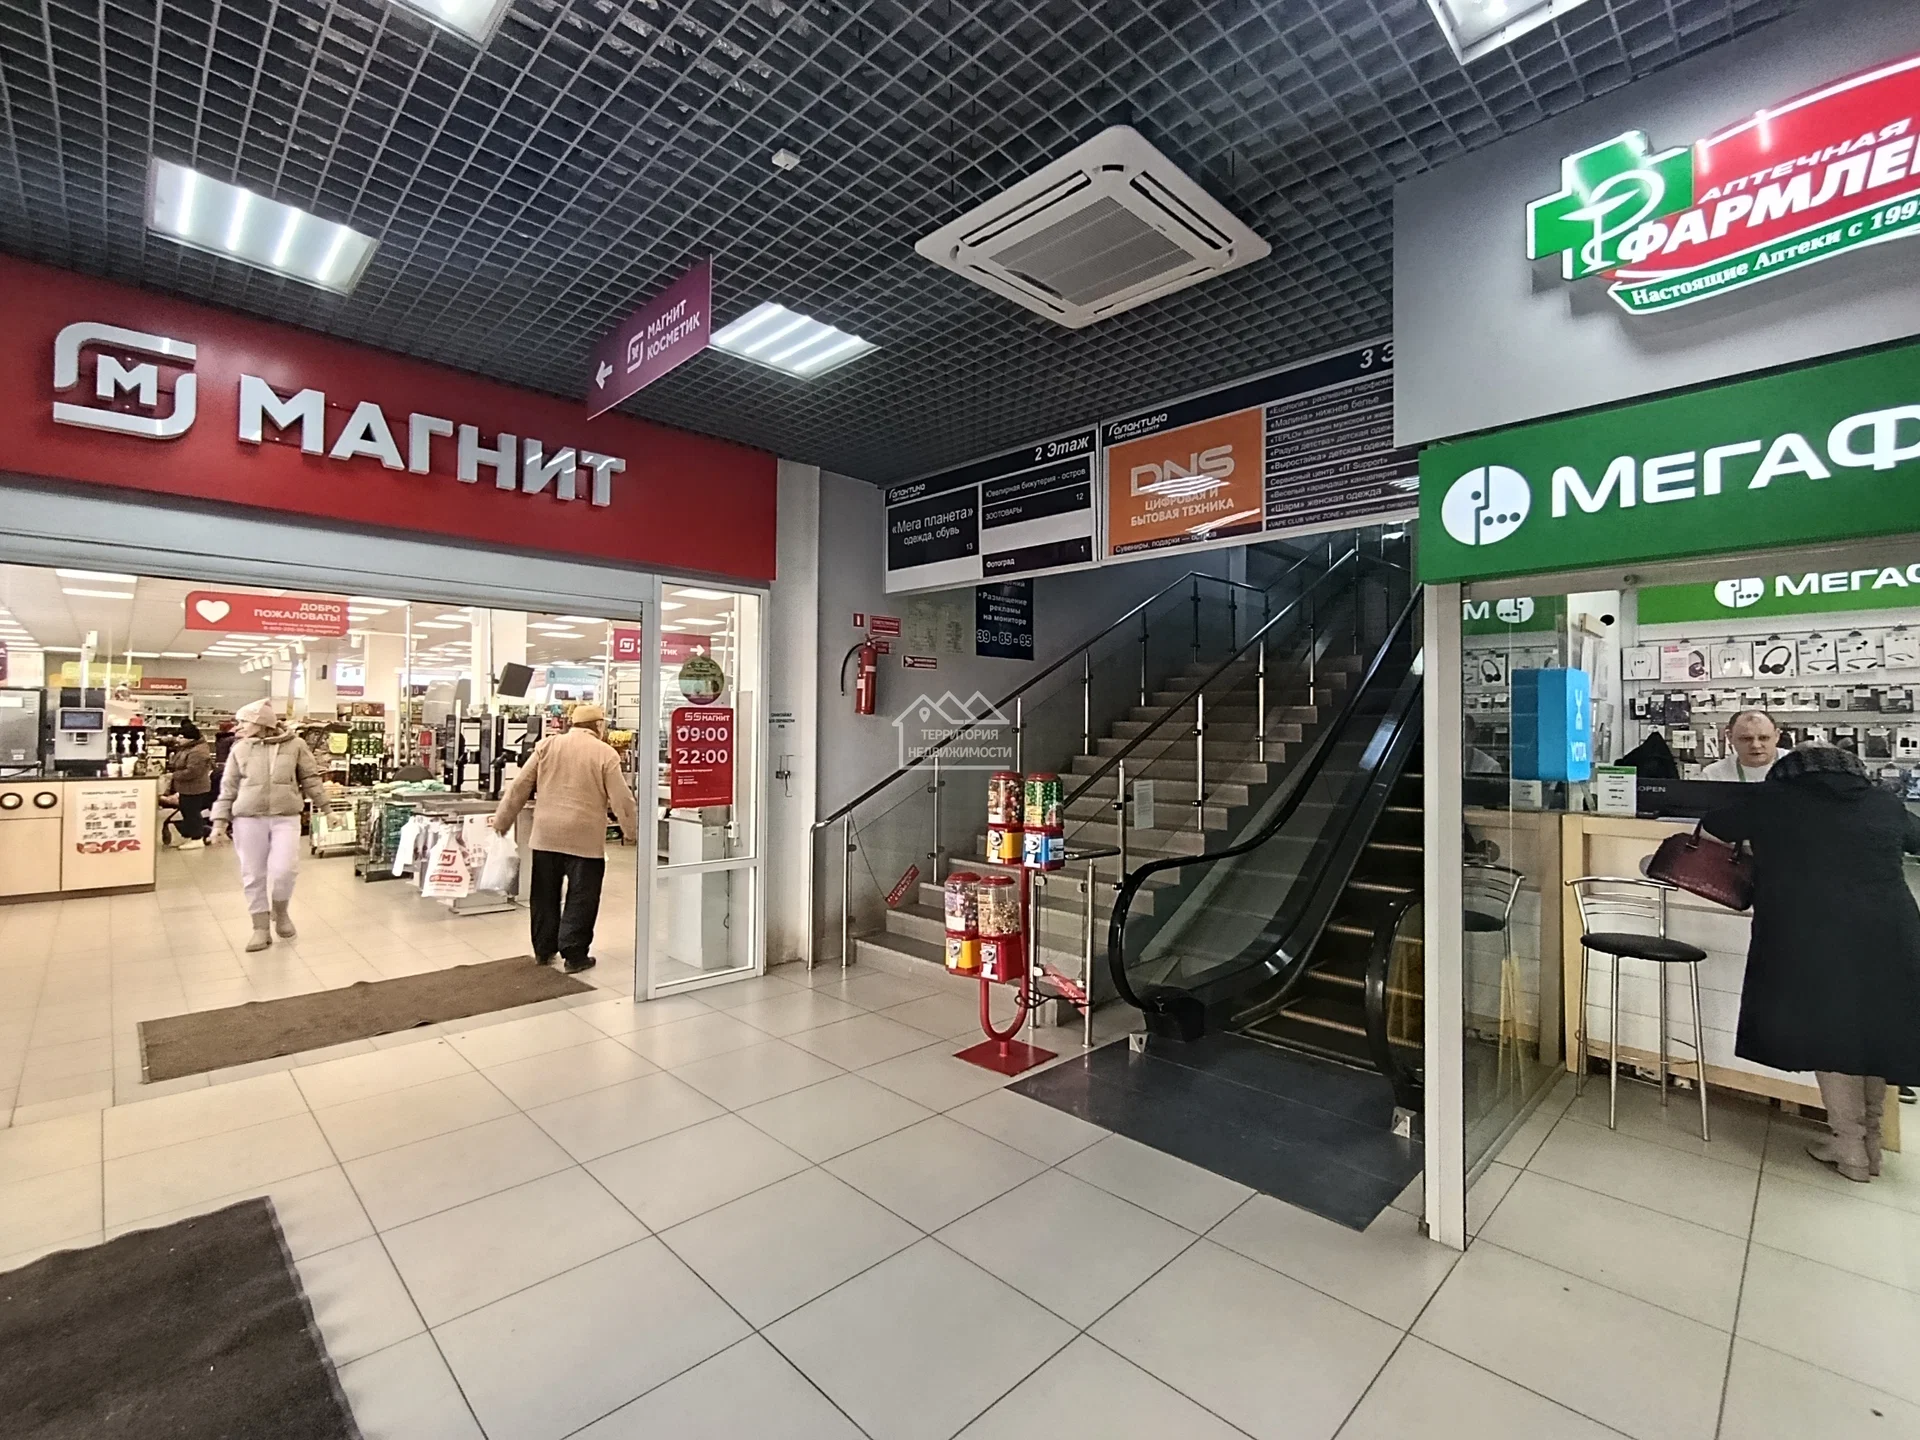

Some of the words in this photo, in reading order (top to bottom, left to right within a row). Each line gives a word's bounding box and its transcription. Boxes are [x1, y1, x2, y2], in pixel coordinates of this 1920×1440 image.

[1697, 117, 1912, 204] АПТЕЧНАЯ
[1617, 132, 1920, 262] ФАРМЛЕ
[1631, 262, 1748, 306] Настоящие
[1753, 229, 1842, 271] Аптеки
[1847, 221, 1864, 237] с
[1869, 199, 1920, 231] 199
[647, 299, 687, 340] МАГНИТ
[647, 311, 700, 361] КОСМЕТИК
[1360, 349, 1373, 369] 3
[1270, 413, 1313, 429] «Малина»
[1315, 404, 1349, 417] нижнее
[1351, 396, 1379, 409] белье
[1333, 415, 1365, 429] мужской
[239, 373, 626, 508] МАГНИТ
[1336, 430, 1369, 443] детская
[1370, 424, 1394, 435] одеж
[1034, 447, 1043, 461] 2
[1047, 436, 1090, 458] Этаж
[1328, 445, 1359, 459] детская
[1061, 468, 1086, 480] остров
[1130, 444, 1235, 498] DNS
[1270, 472, 1311, 486] Сервисный
[1312, 467, 1334, 479] центр
[1270, 486, 1306, 498] «Веселый
[1350, 469, 1397, 484] канцелярия
[1076, 492, 1084, 501] 12
[1270, 501, 1304, 513] «Шарм»
[1307, 494, 1344, 507] женская
[1346, 487, 1382, 500] одежда
[892, 520, 922, 534] «Мега
[924, 507, 974, 528] планета»
[985, 506, 1023, 520] ЗООТОВАРЫ
[1130, 508, 1180, 527] БЫТОВАЯ
[1182, 498, 1234, 518] ТЕХНИКА
[903, 531, 934, 546] одежда,
[936, 526, 960, 539] обувь
[1151, 537, 1180, 549] подарки
[300, 602, 341, 613] ДОБРО
[982, 591, 1028, 606] Размещение
[254, 609, 341, 622] ПОЖАЛОВАТЬ!
[989, 604, 1021, 614] рекламы
[994, 615, 1027, 625] мониторе
[976, 629, 990, 643] 39
[1019, 633, 1032, 647] 95
[677, 727, 728, 742] 09:00
[678, 749, 728, 765] 22:00
